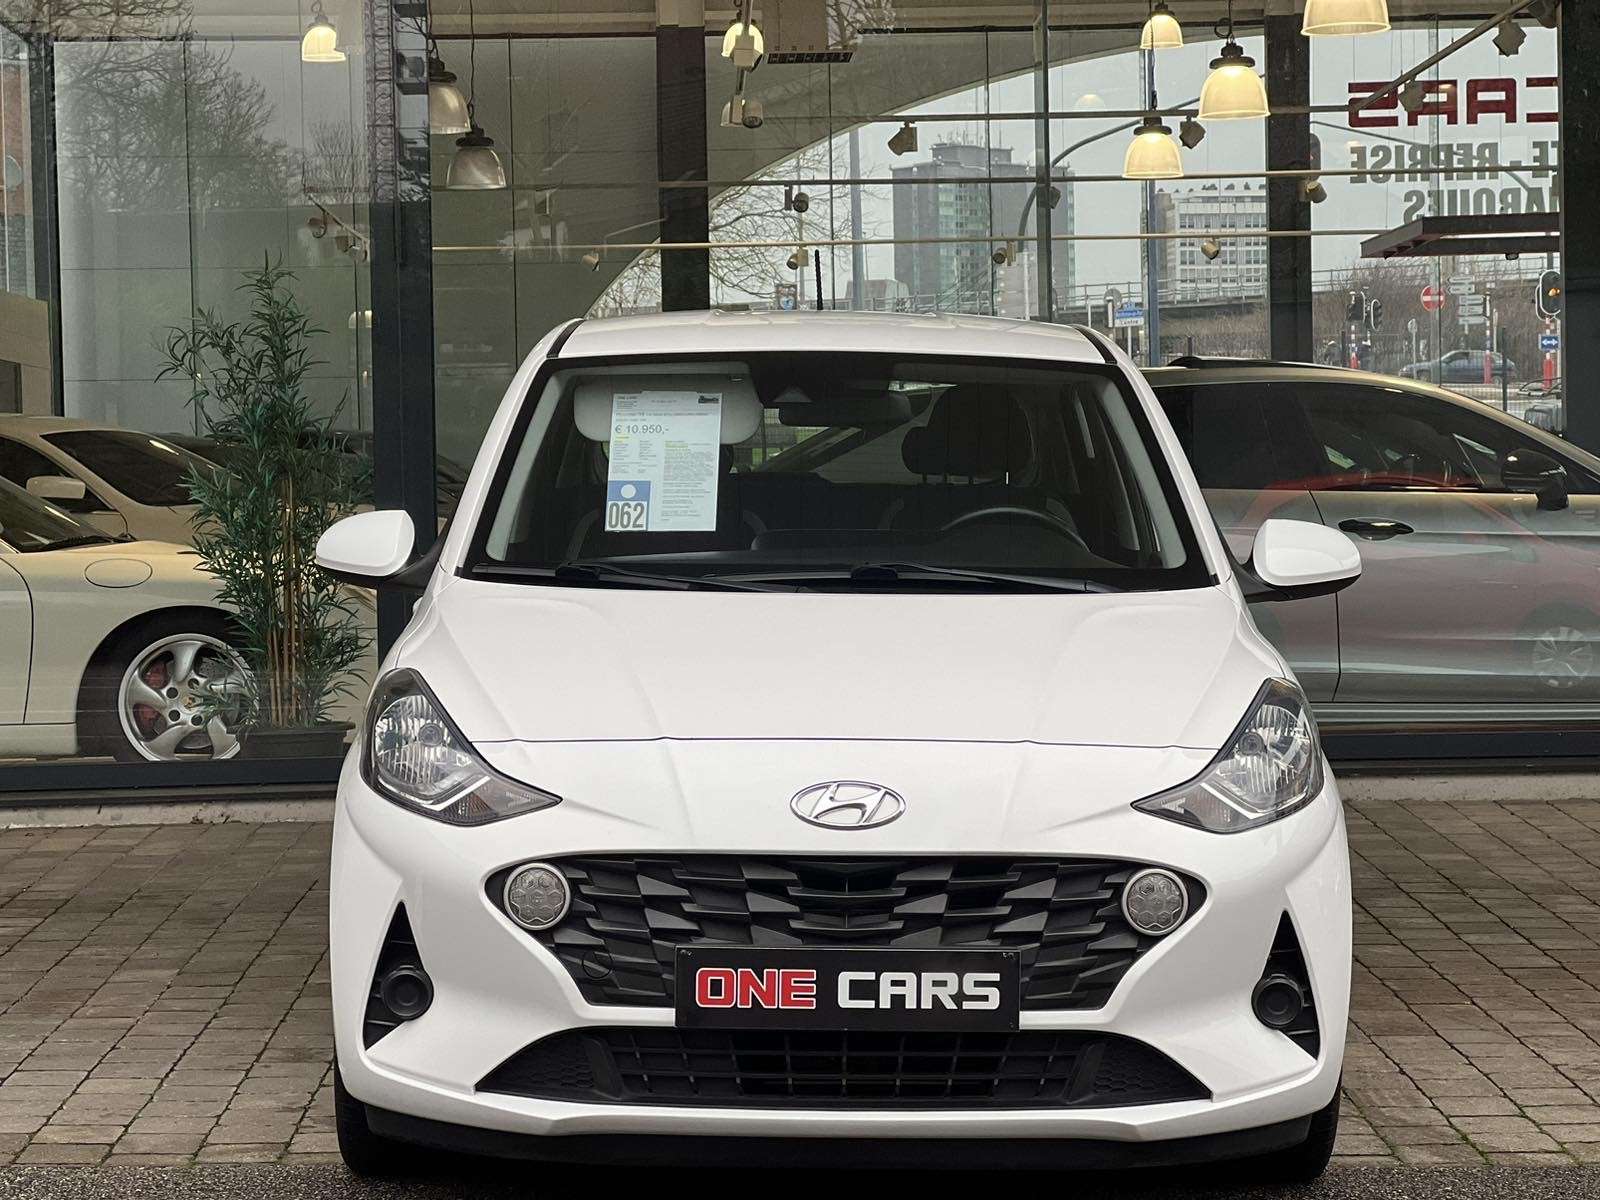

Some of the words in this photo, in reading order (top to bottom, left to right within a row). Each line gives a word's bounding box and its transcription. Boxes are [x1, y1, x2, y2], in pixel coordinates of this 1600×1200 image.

[626, 424, 669, 435] 10.950,-
[608, 502, 645, 529] 062
[695, 967, 817, 1009] ONE
[838, 971, 1001, 1010] CARS
